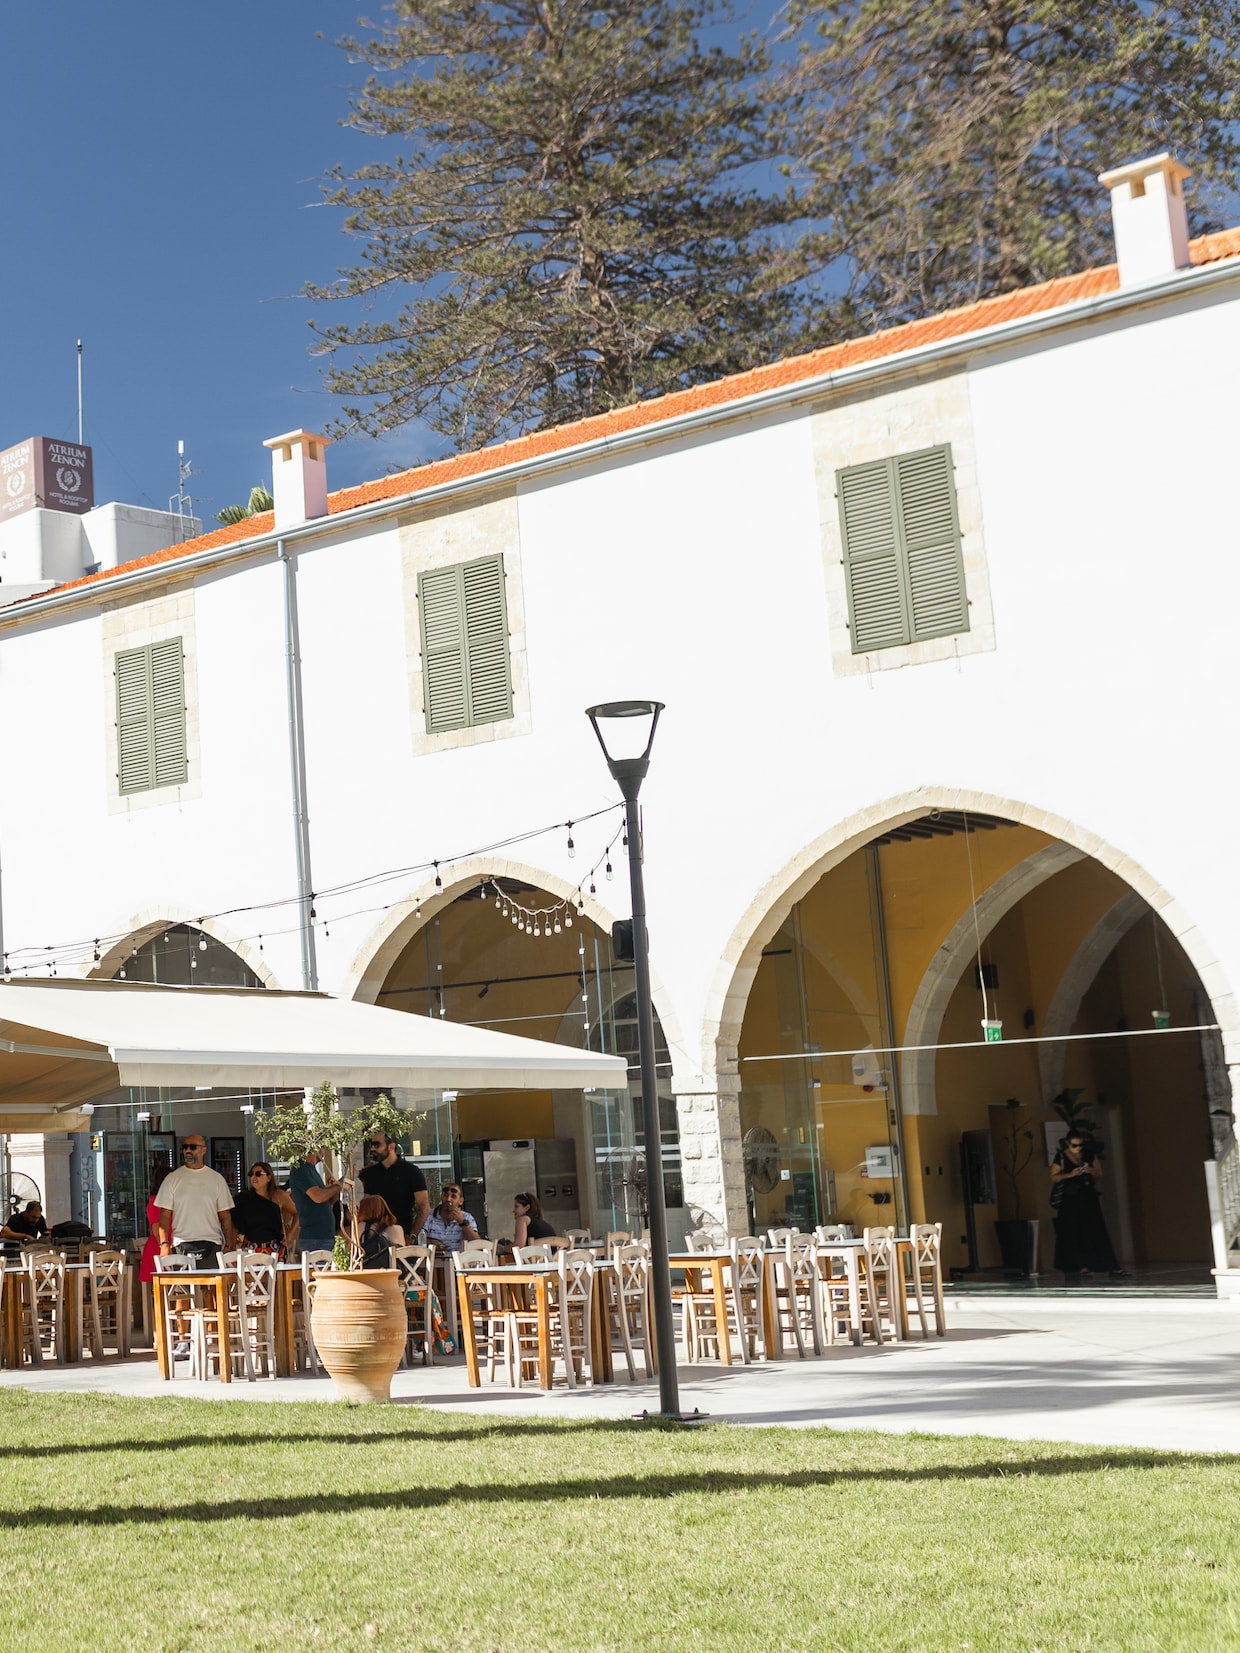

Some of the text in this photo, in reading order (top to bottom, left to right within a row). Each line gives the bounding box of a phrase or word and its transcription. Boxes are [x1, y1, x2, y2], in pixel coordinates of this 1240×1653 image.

[1, 445, 30, 465] ATRIUM
[48, 443, 87, 459] ATRIUM
[51, 453, 85, 467] ZENON
